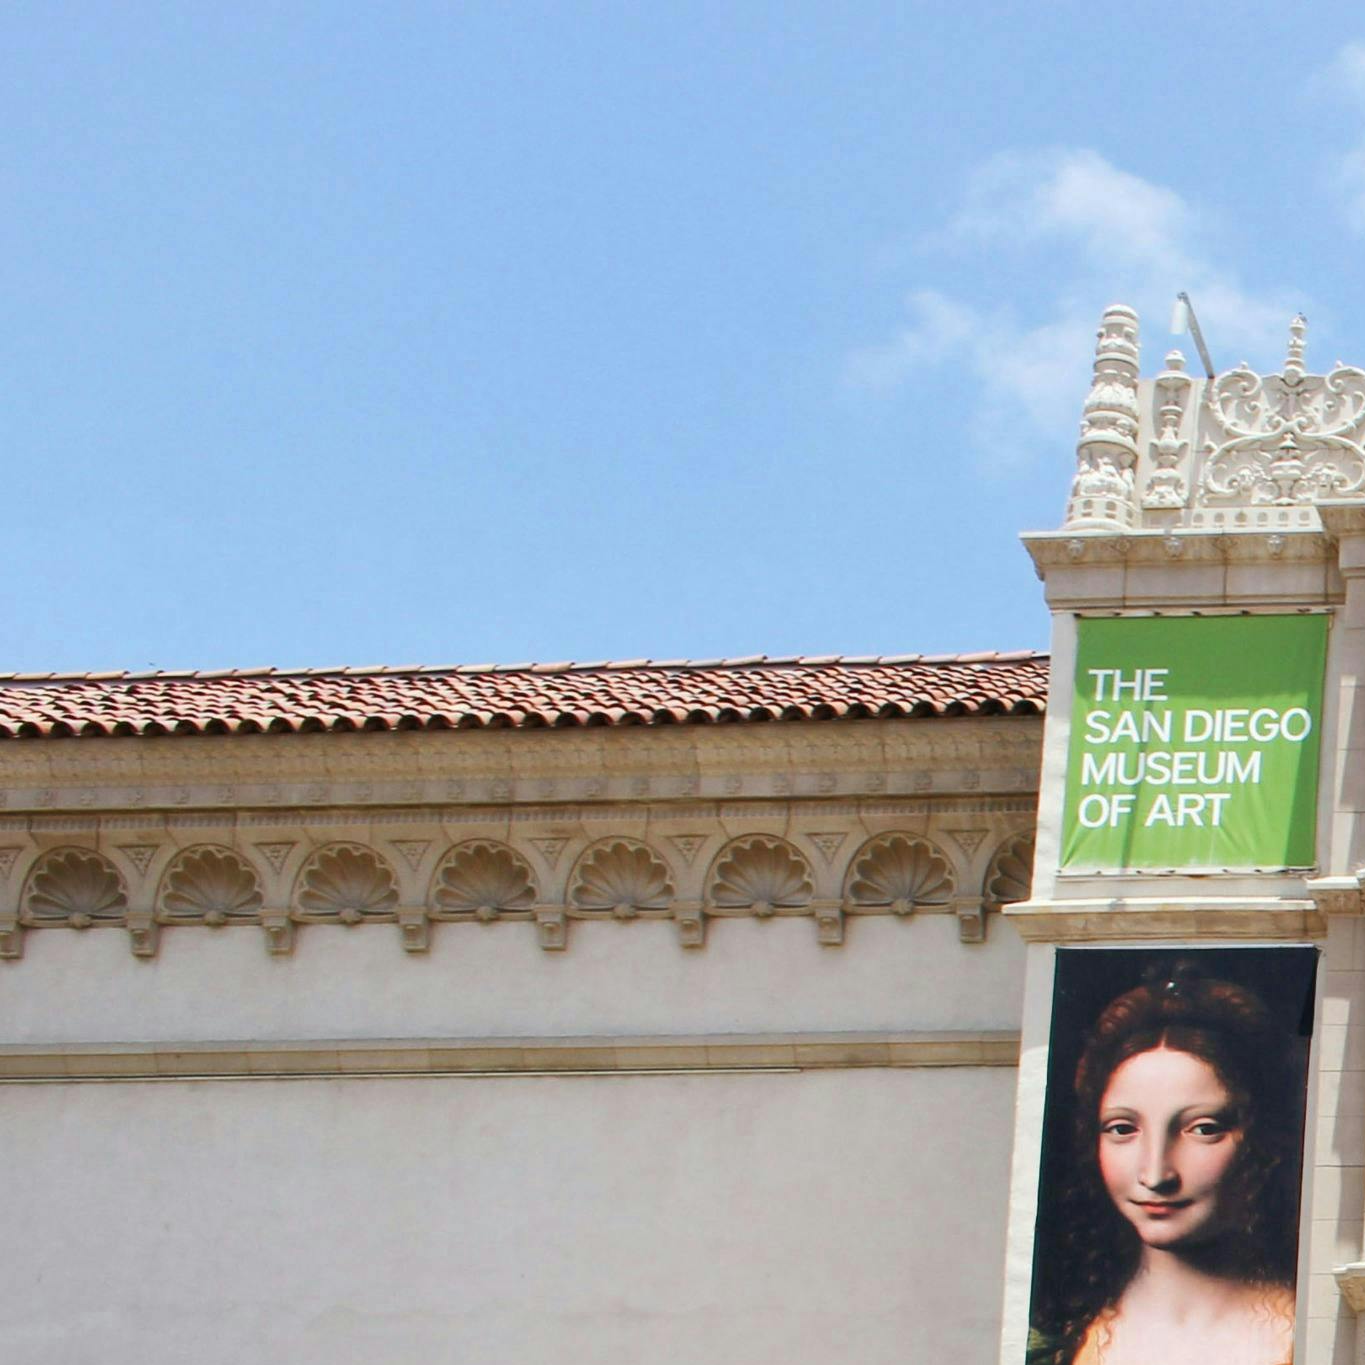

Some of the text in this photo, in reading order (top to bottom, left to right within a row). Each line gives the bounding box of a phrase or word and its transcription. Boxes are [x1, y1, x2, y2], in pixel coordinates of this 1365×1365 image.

[1088, 669, 1169, 701] THE
[1084, 707, 1312, 744] SAN DIEGO
[1081, 751, 1261, 785] MUSEUM
[1078, 793, 1231, 828] OF ART
